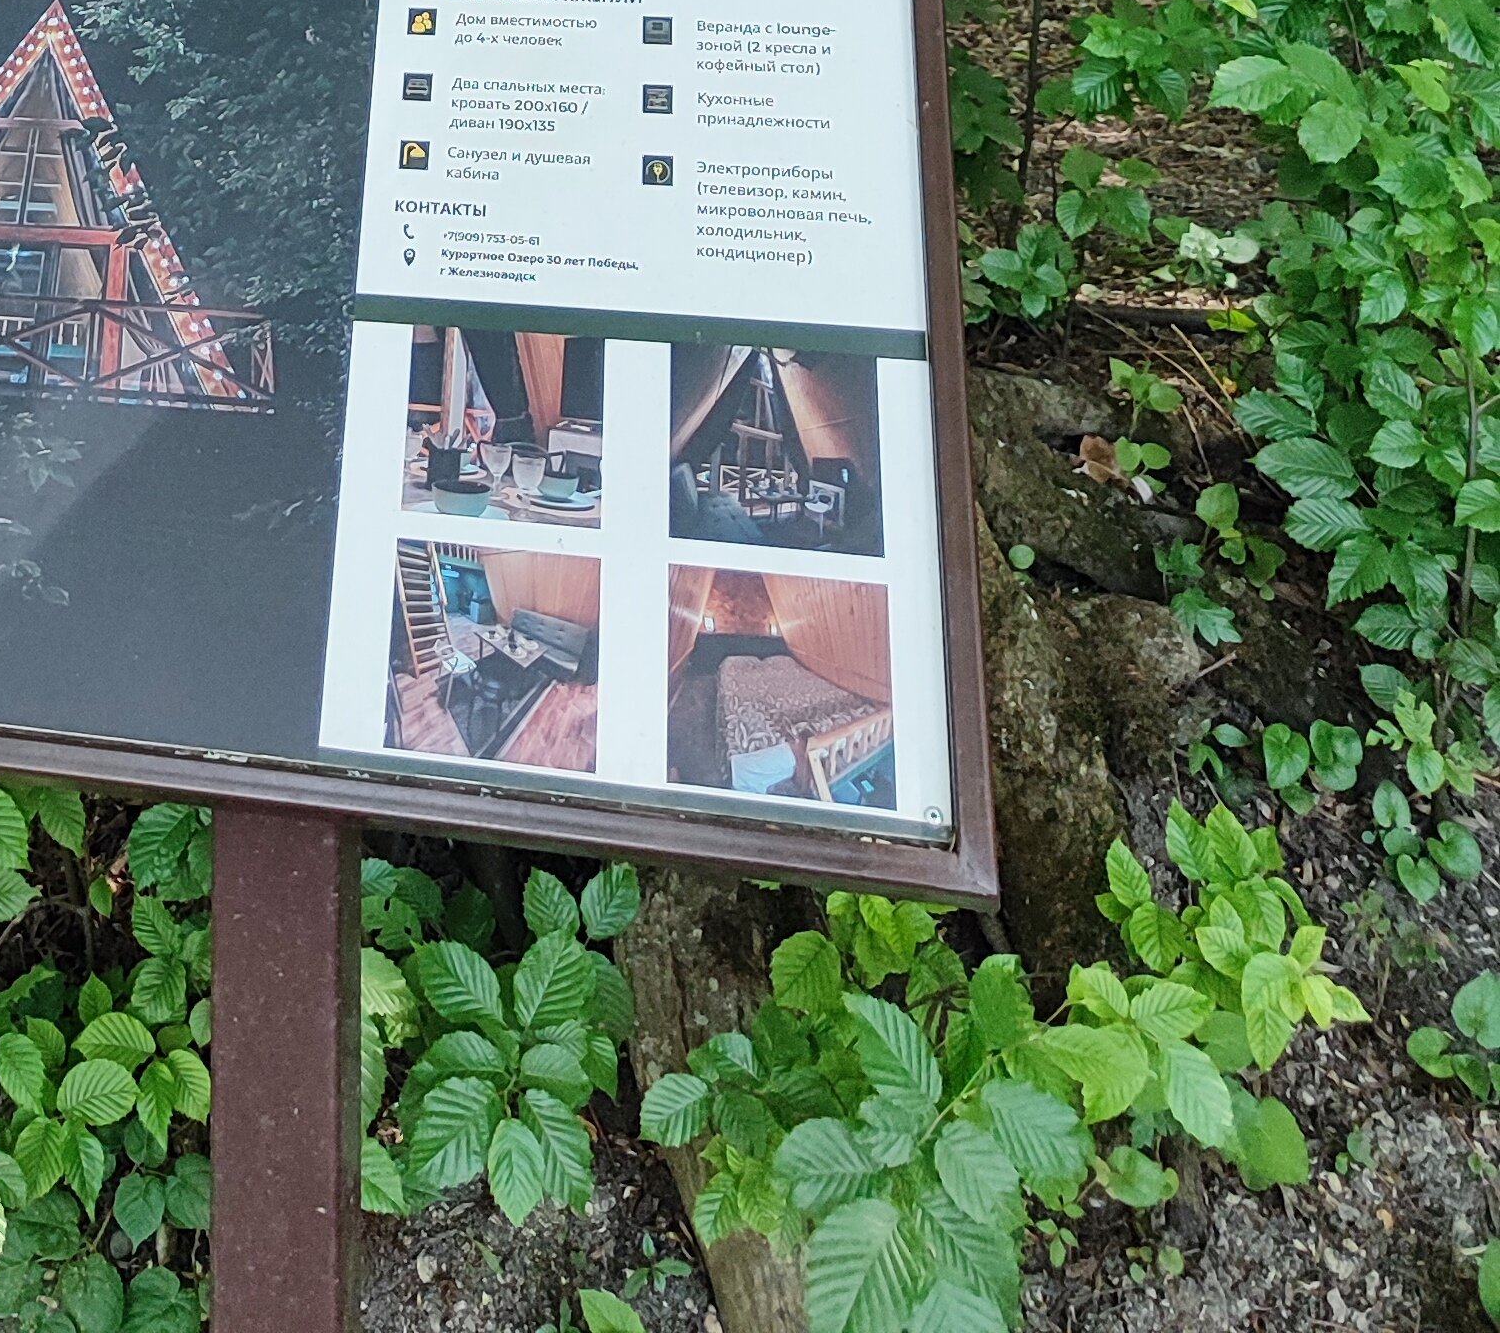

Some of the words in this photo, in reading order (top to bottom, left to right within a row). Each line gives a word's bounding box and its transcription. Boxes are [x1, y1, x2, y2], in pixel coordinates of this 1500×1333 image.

[455, 13, 486, 27] Дом
[490, 16, 598, 29] вместимостью
[696, 20, 761, 35] Веранда
[776, 22, 836, 38] lounge-
[454, 33, 473, 45] до
[502, 35, 563, 47] человек
[696, 39, 742, 52] зоной
[747, 41, 761, 54] (2
[765, 44, 817, 56] кресла
[821, 45, 831, 55] и
[696, 58, 776, 74] кофейный
[780, 62, 821, 76] стол)
[451, 77, 479, 92] Два
[483, 81, 555, 93] спальных
[450, 98, 511, 112] кровать
[697, 92, 774, 108] Кухонные
[448, 118, 495, 130] диван
[696, 113, 831, 129] принадлежности
[447, 146, 507, 161] Санузел
[511, 151, 521, 161] и
[524, 152, 591, 166] душевая
[446, 167, 500, 181] кабина
[696, 161, 833, 182] Электроприборы
[696, 181, 788, 201] (телевизор,
[792, 188, 847, 202] камин,
[394, 199, 487, 217] КОНТАКТЫ
[696, 204, 824, 221] микроволновая
[828, 210, 872, 225] печь,
[696, 225, 807, 242] холодильник,
[507, 252, 544, 265] Озеро
[546, 255, 562, 265] 30
[563, 257, 585, 267] лет
[696, 246, 813, 266] кондиционер)
